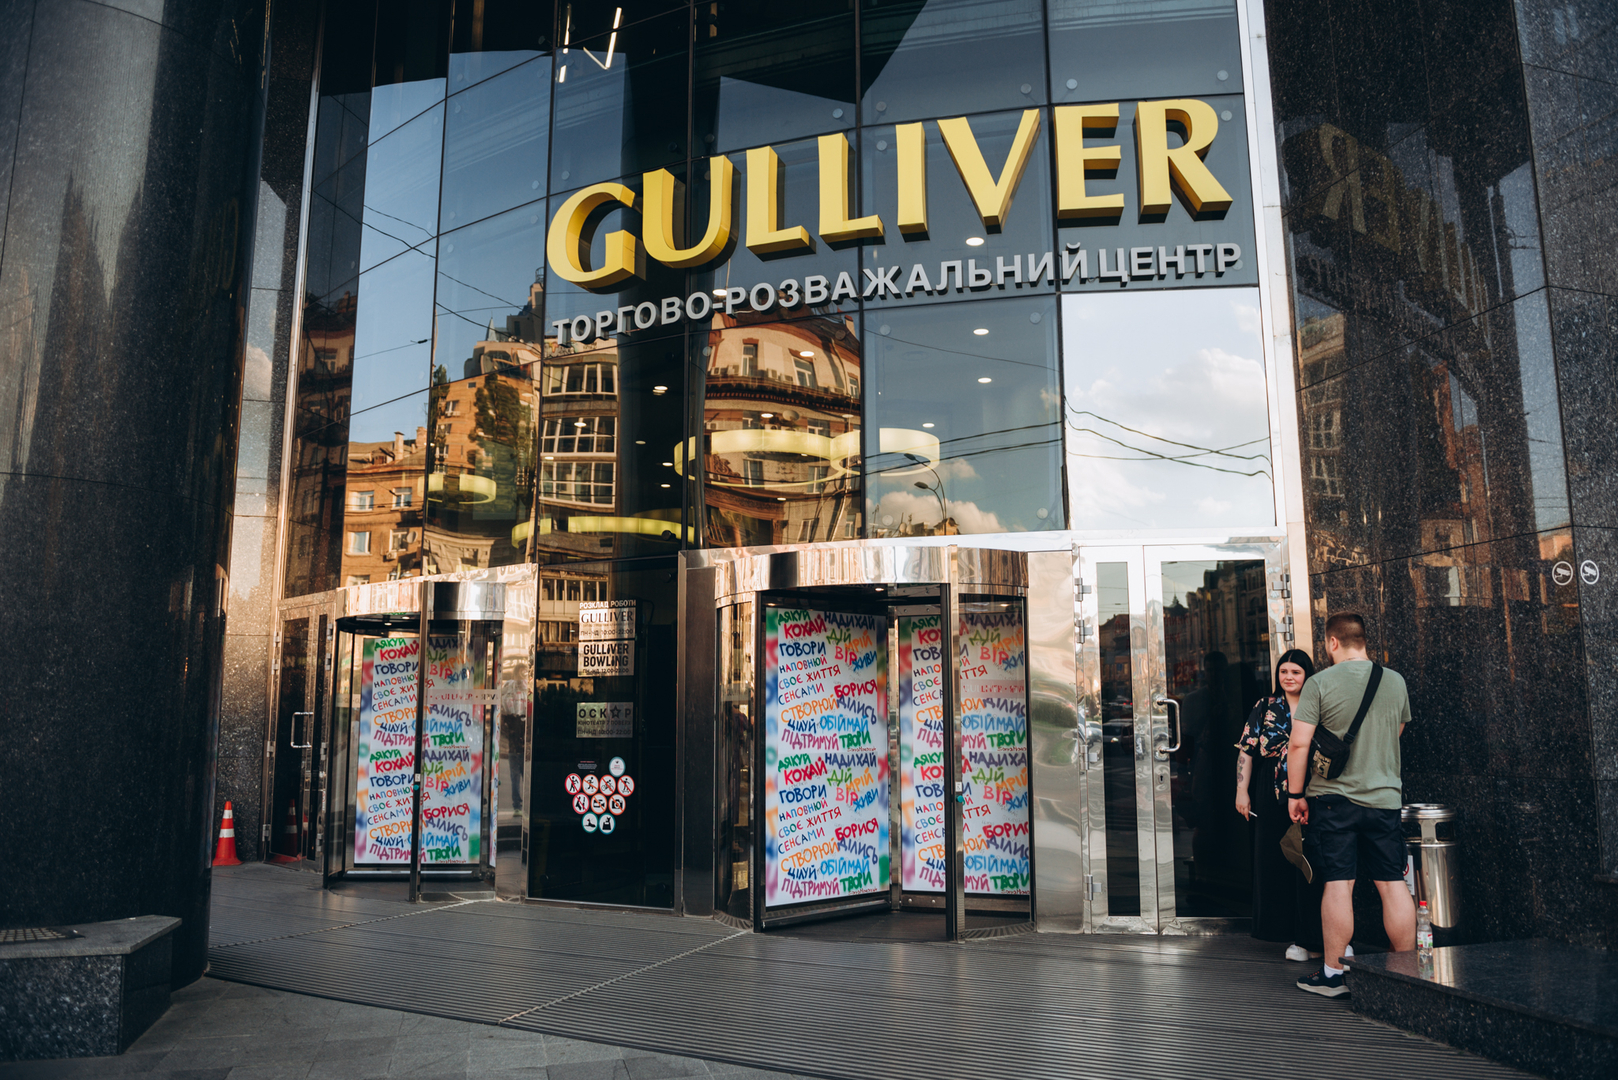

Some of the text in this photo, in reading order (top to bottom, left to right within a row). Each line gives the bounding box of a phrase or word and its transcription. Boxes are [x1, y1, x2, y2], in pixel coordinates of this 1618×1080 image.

[547, 99, 1234, 292] GULLIVER
[552, 242, 1243, 347] ТОРГОВО-РОЗВАЖАЛЬНИЙ ЦЕНТР
[580, 601, 609, 609] РОЗКЛАД
[581, 611, 633, 623] GULLIVER
[778, 610, 810, 625] ДЯКУЙ
[784, 614, 827, 639] КОХАЙ
[824, 611, 875, 630] НАДИХАЙ
[911, 616, 941, 632] ДЯКУ
[374, 638, 406, 651] ДЯКУЙ
[826, 628, 851, 645] ДІЙ
[844, 629, 873, 652] МРІЙ
[969, 628, 1001, 646] ДІЙ
[584, 644, 629, 655] GULLIVER
[779, 641, 826, 657] ГОВОРИ
[835, 646, 858, 665] ВІР
[584, 656, 629, 667] BOWLING
[779, 654, 828, 674] НАПОВНЮЙ
[852, 650, 877, 672] ЖИВИ
[779, 674, 803, 689] СВОЄ
[806, 664, 841, 682] ЖИТТЯ
[913, 676, 941, 692] СВОЄ
[373, 688, 397, 700] СВОЄ
[778, 683, 824, 705] СЕНСАМИ
[834, 679, 878, 698] БОРИСЯ
[372, 694, 418, 712] СЕНСАМИ
[781, 694, 839, 723] СТВОРЮЙ
[837, 695, 877, 725] ДІЛИСЬ
[983, 698, 1025, 717] ДІЛИС
[430, 704, 471, 727] ДІЛИСЬ
[788, 714, 868, 733] ЦІЛУЙ ОБІЙМАЙ
[962, 713, 1026, 732] ОБІЙМАЙ
[380, 722, 408, 734] ЦІЛУЙ
[431, 732, 465, 746] ТВОРИ
[782, 728, 872, 751] ПІДТРИМУЙ ТВОРИ
[370, 749, 402, 763] ДЯКУЙ
[421, 750, 470, 762] АДИХАЙ
[778, 753, 811, 772] ДЯКУЙ
[825, 752, 877, 769] НАДИХАЙ
[914, 752, 944, 769] ДЯКУ
[969, 751, 1027, 768] НАДИХА
[436, 762, 466, 782] МРІЙ
[784, 756, 828, 785] КОХАЙ
[827, 768, 852, 787] ДІЙ
[846, 767, 874, 792] МРІЙ
[972, 767, 1005, 785] ДІЙ
[995, 767, 1027, 792] МРІЙ
[444, 779, 470, 797] ЖИВИ
[779, 784, 827, 804] ГОВОРИ
[836, 788, 858, 806] ВІР
[368, 800, 392, 813] СВОЄ
[779, 797, 828, 821] НАПОВНЮЙ
[853, 788, 879, 812] ЖИВИ
[368, 807, 413, 825] СЕНСАМИ
[423, 803, 470, 819] БОРИСЯ
[425, 817, 468, 841] ДІЛИСЬ
[779, 821, 803, 838] СВОЄ
[807, 806, 842, 828] ЖИТТЯ
[834, 818, 879, 841] БОРИСЯ
[915, 814, 943, 830] СВОЄ
[983, 822, 1028, 838] БОРИС
[376, 835, 404, 848] ЦІЛУЙ
[778, 827, 826, 854] СЕНСАМИ
[987, 835, 1029, 860] ДІЛИС
[427, 846, 461, 861] ТВОРИ
[781, 837, 840, 872] СТВОРЮЙ
[837, 837, 878, 864] ДІЛИСЬ
[787, 855, 870, 880] ЦІЛУЙ ОБІЙМАЙ
[966, 855, 1029, 874] ОБІЙМАЙ
[781, 871, 873, 899] ПІДТРИМУЙ ТВОРИ
